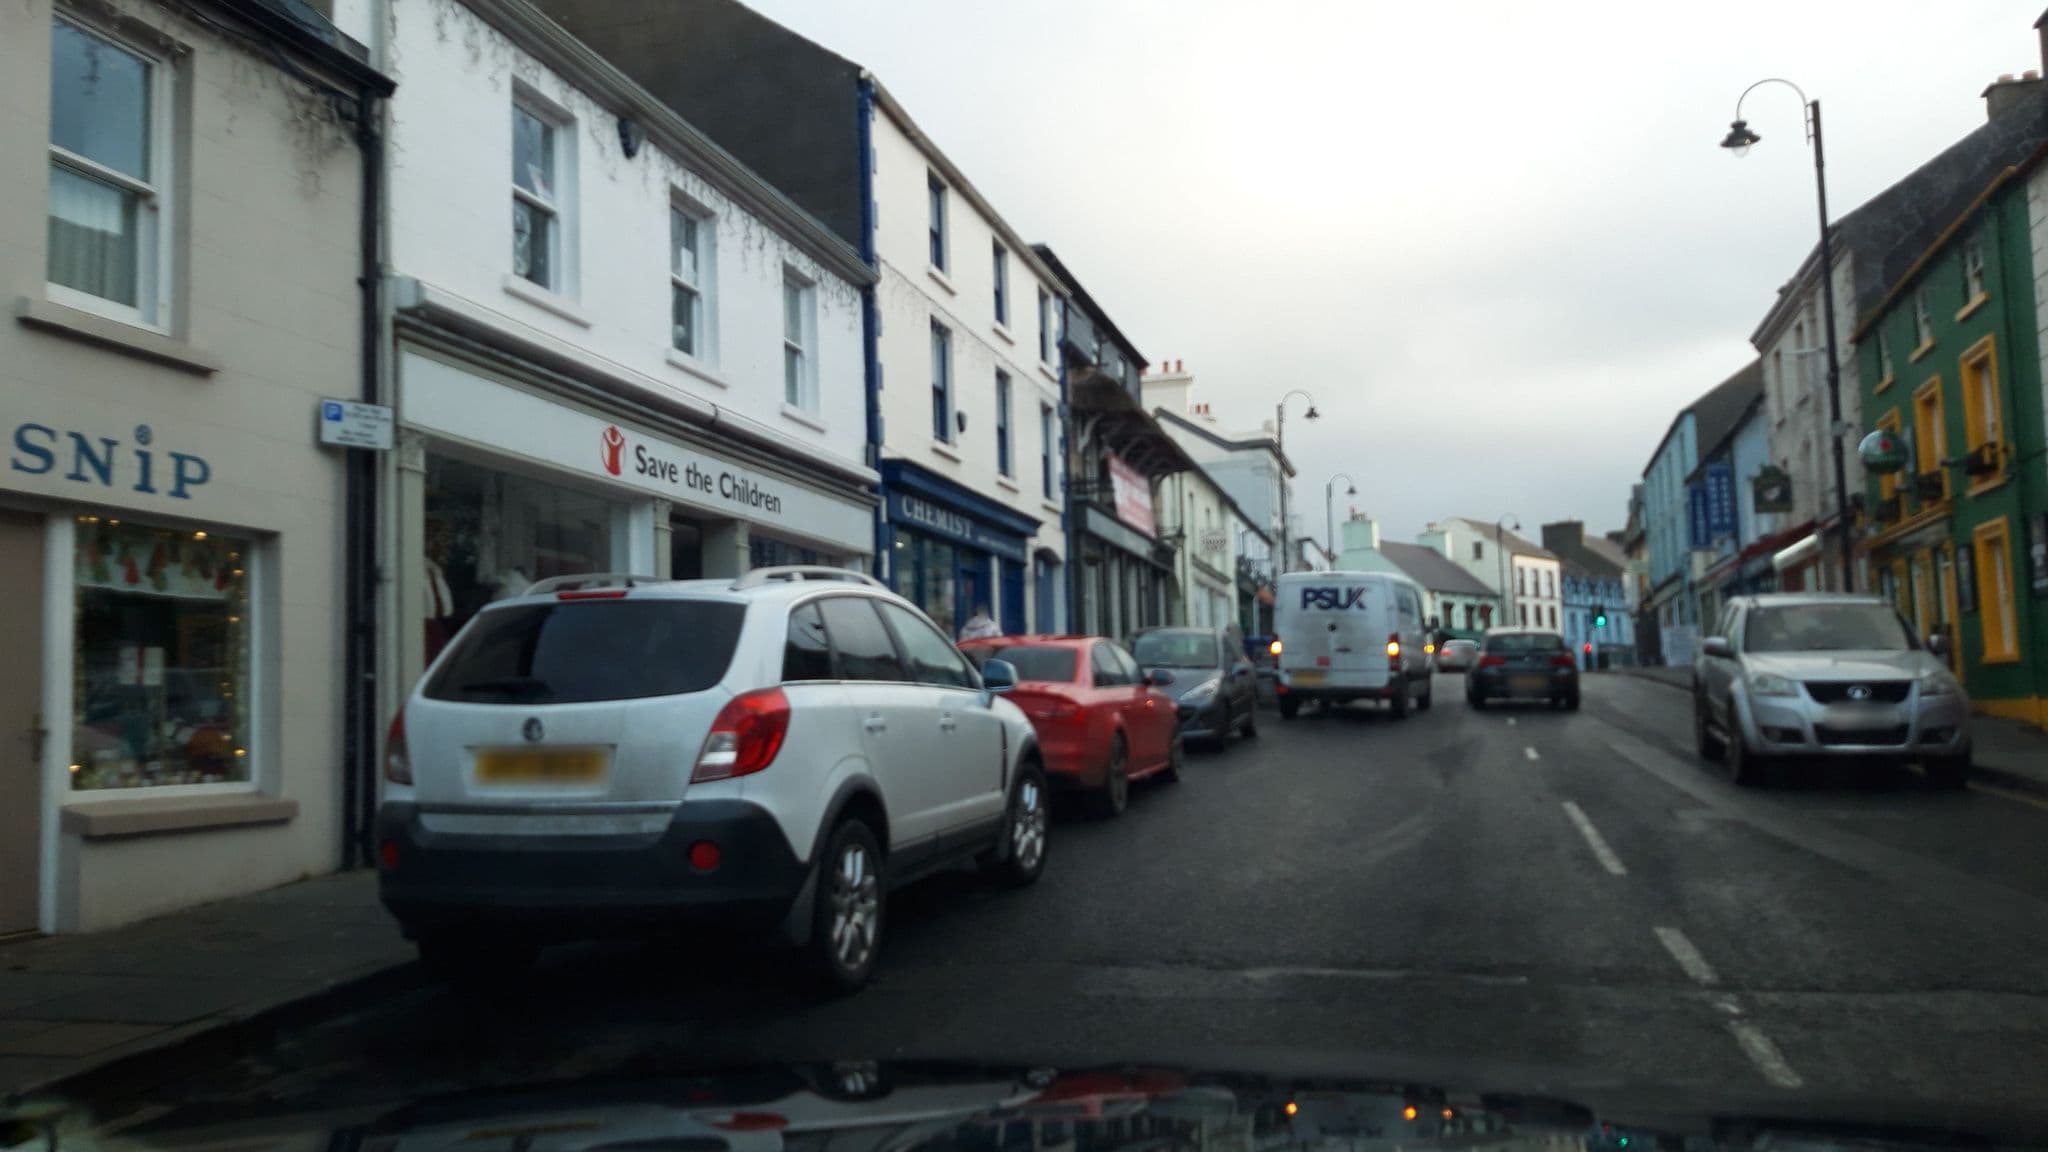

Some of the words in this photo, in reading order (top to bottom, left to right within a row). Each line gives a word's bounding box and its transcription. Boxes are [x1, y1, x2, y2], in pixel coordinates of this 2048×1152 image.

[635, 444, 679, 483] Save
[685, 462, 713, 493] the
[719, 471, 782, 515] Children
[901, 494, 974, 540] CHEMIST
